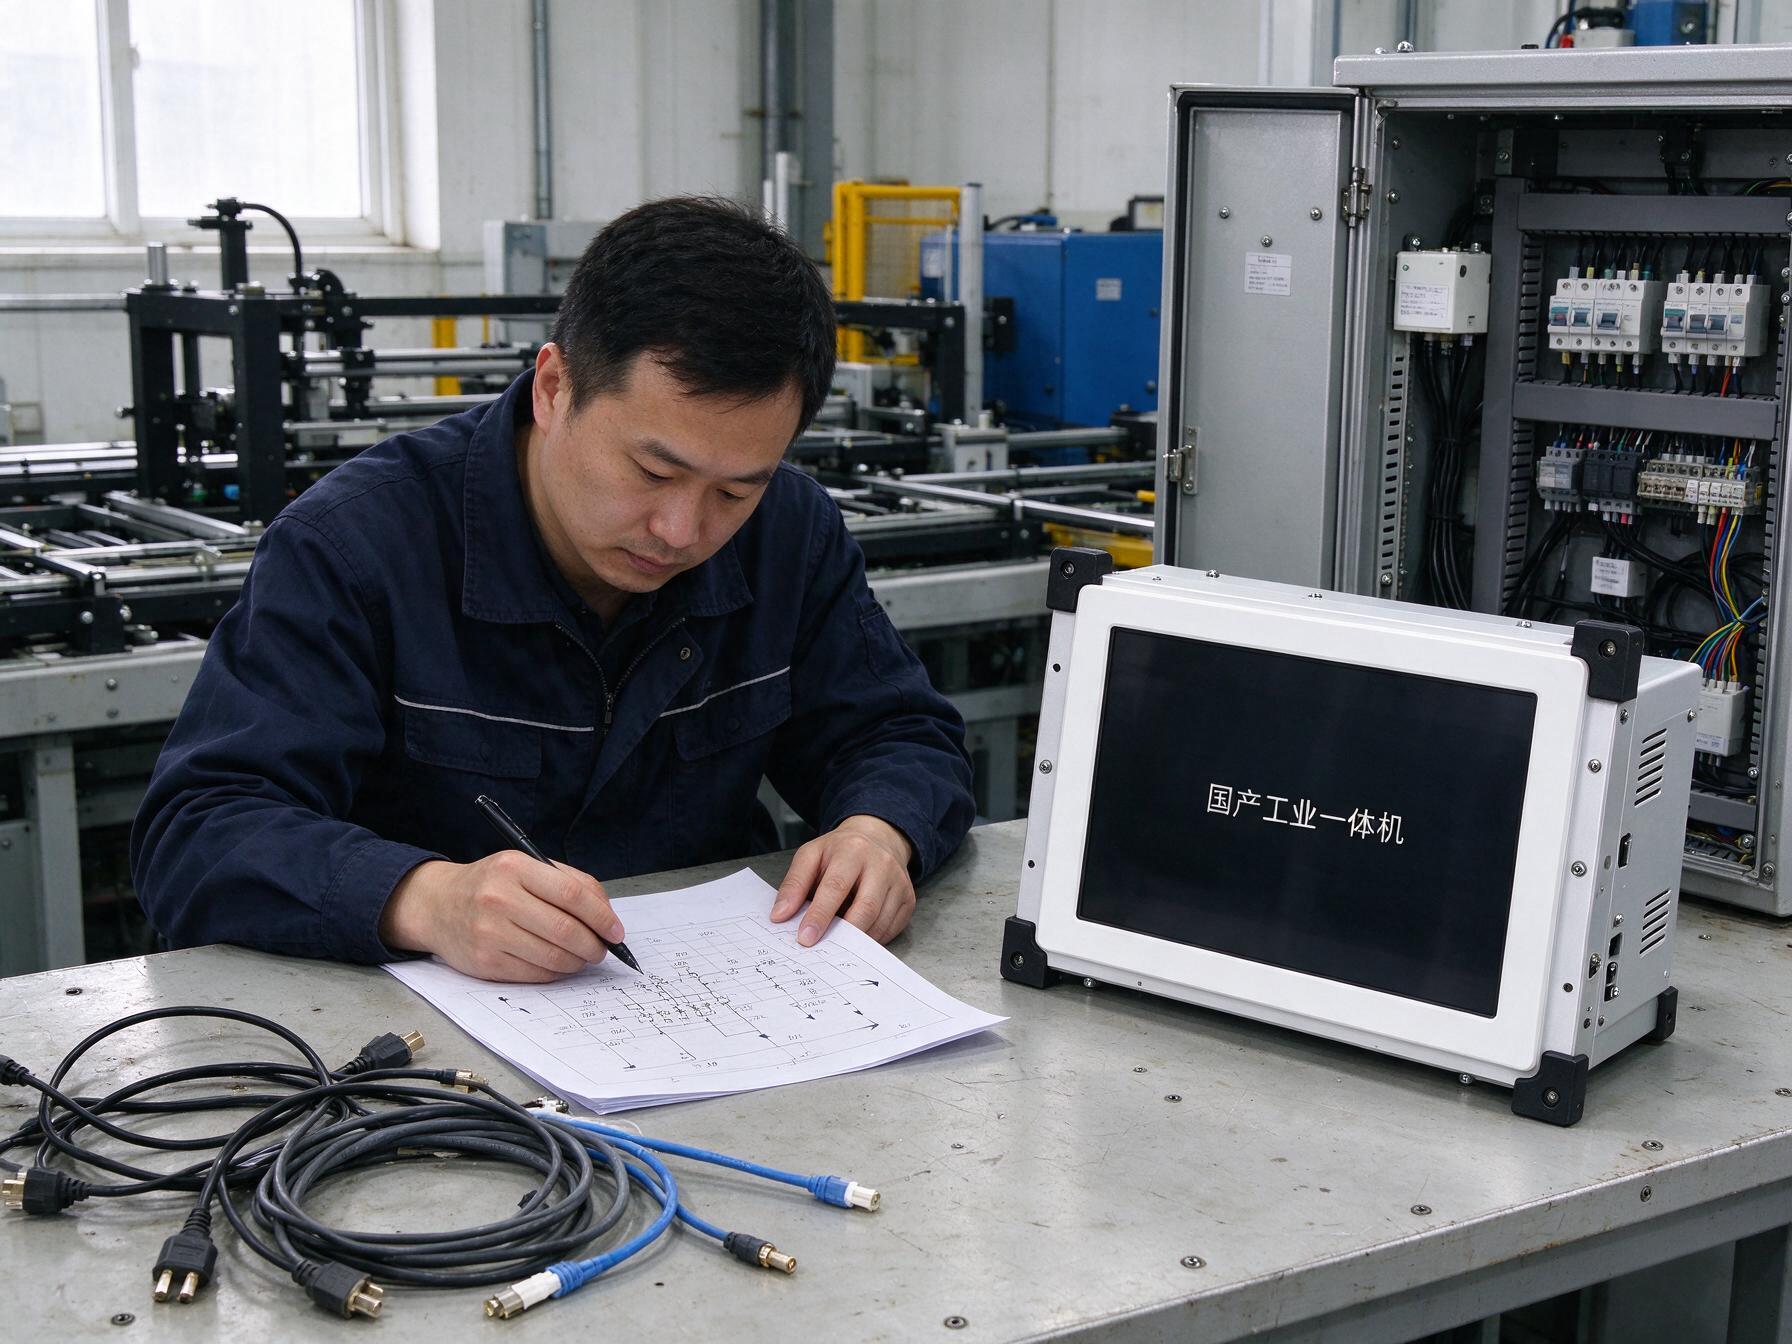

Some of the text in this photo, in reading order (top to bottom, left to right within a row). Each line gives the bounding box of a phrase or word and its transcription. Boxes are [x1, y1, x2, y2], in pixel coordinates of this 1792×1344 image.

[1207, 783, 1404, 845] 国产工业一体机
